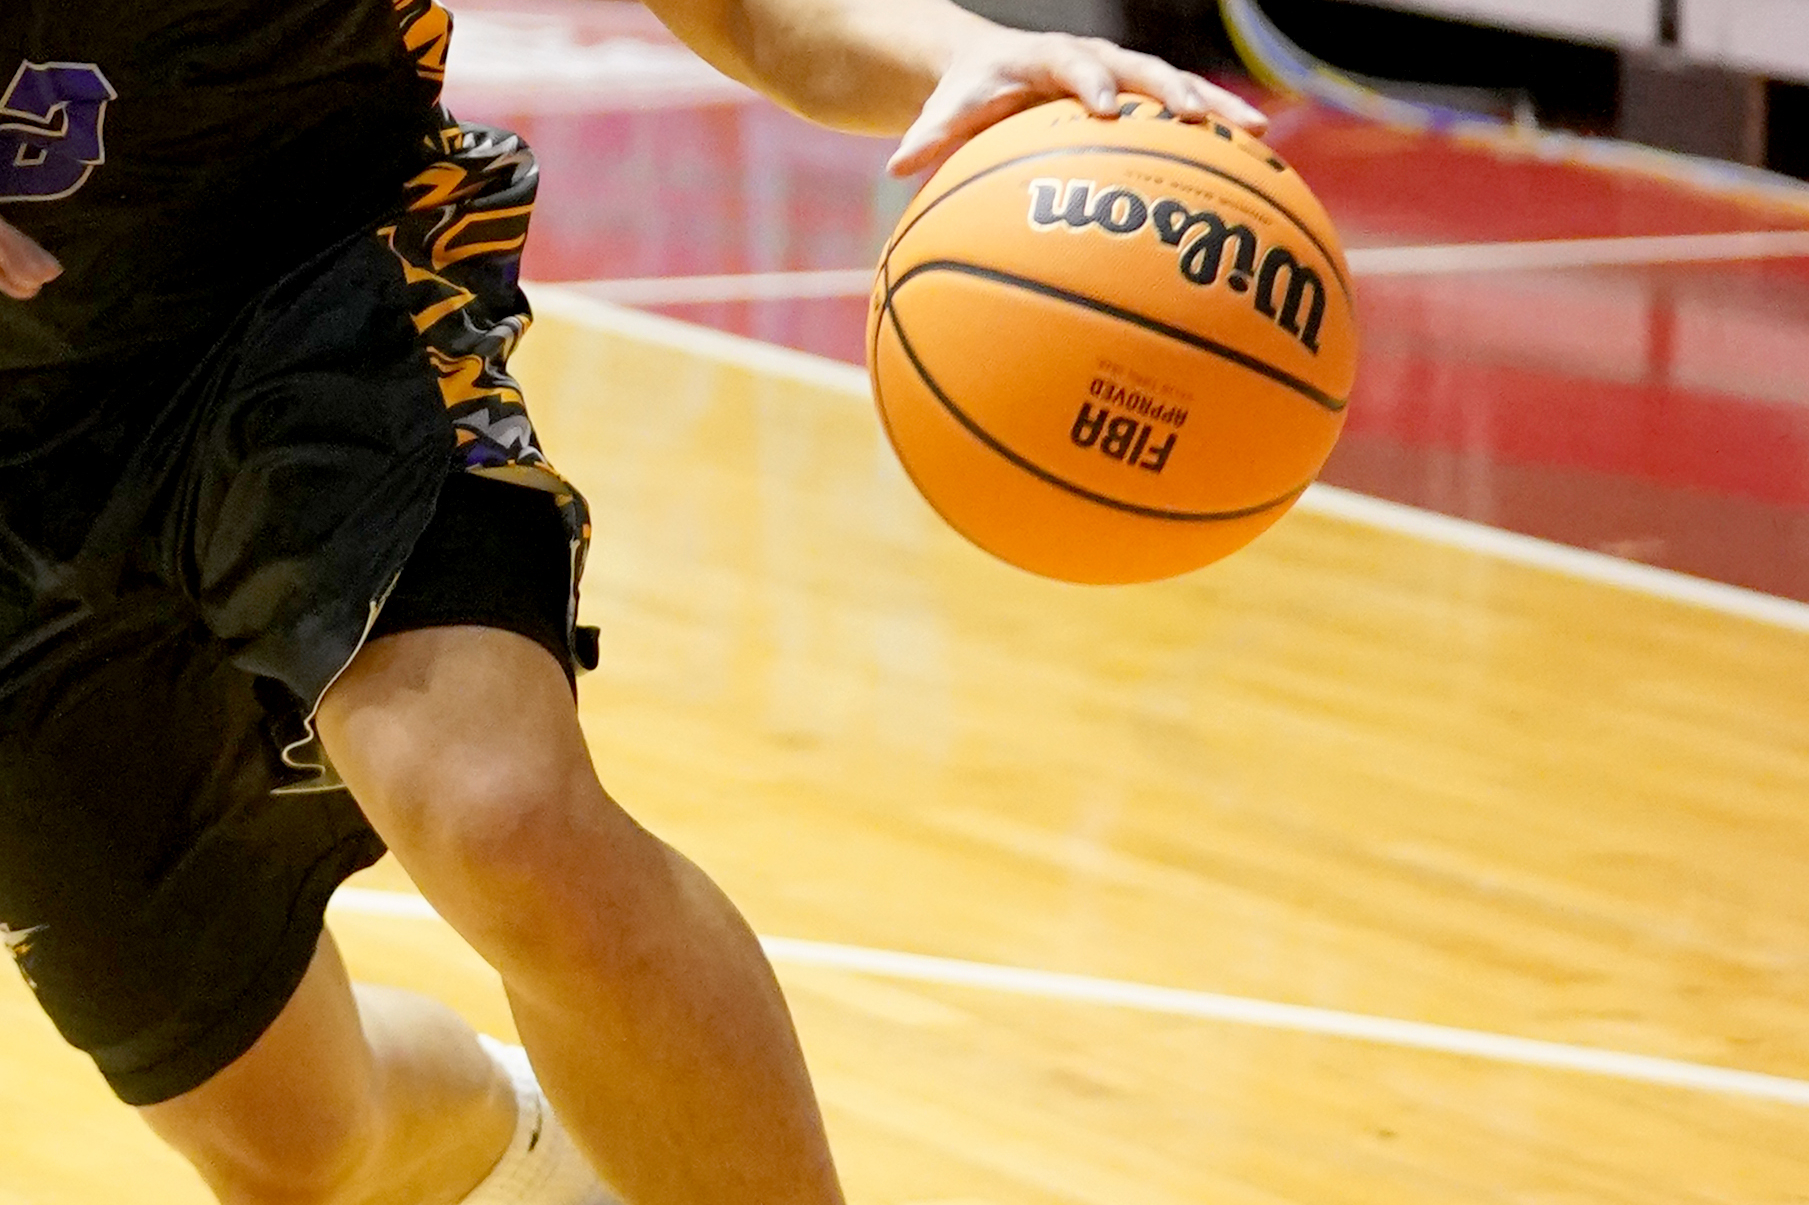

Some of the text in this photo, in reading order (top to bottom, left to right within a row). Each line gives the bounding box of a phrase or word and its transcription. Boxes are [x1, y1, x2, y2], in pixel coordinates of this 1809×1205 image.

[1029, 177, 1328, 357] Wilson
[1070, 401, 1179, 474] FIBA
[1090, 378, 1189, 428] APPROVED
